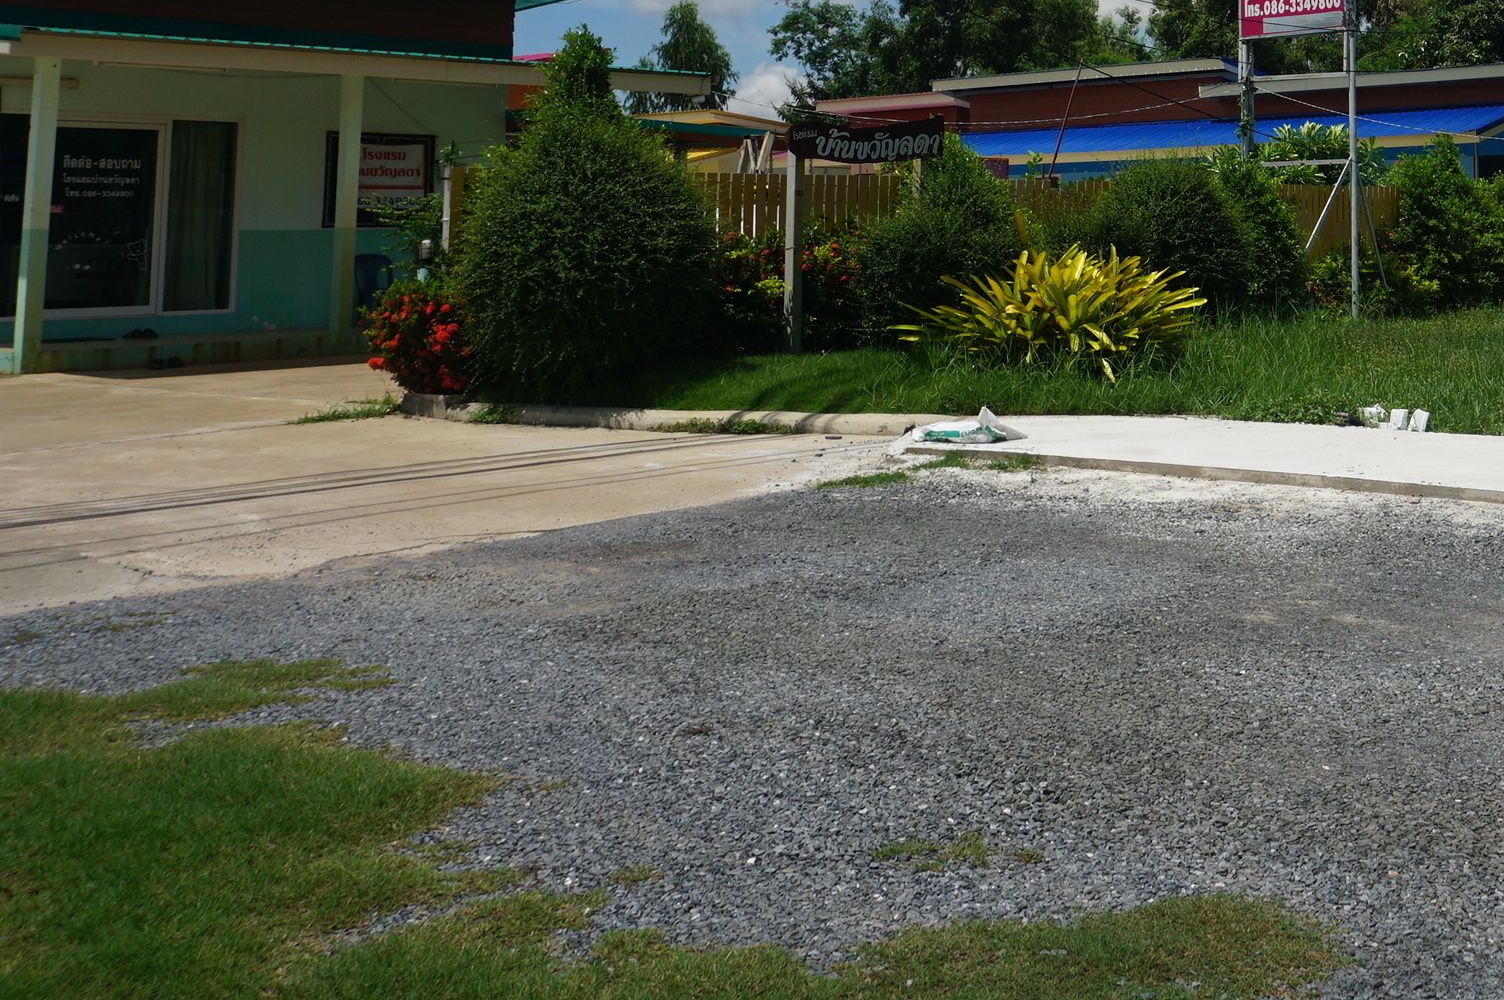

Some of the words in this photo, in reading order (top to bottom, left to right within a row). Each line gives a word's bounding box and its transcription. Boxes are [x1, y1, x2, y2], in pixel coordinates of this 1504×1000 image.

[362, 147, 407, 160] โรงแรม
[816, 128, 941, 161] บ้านขวัญลดา
